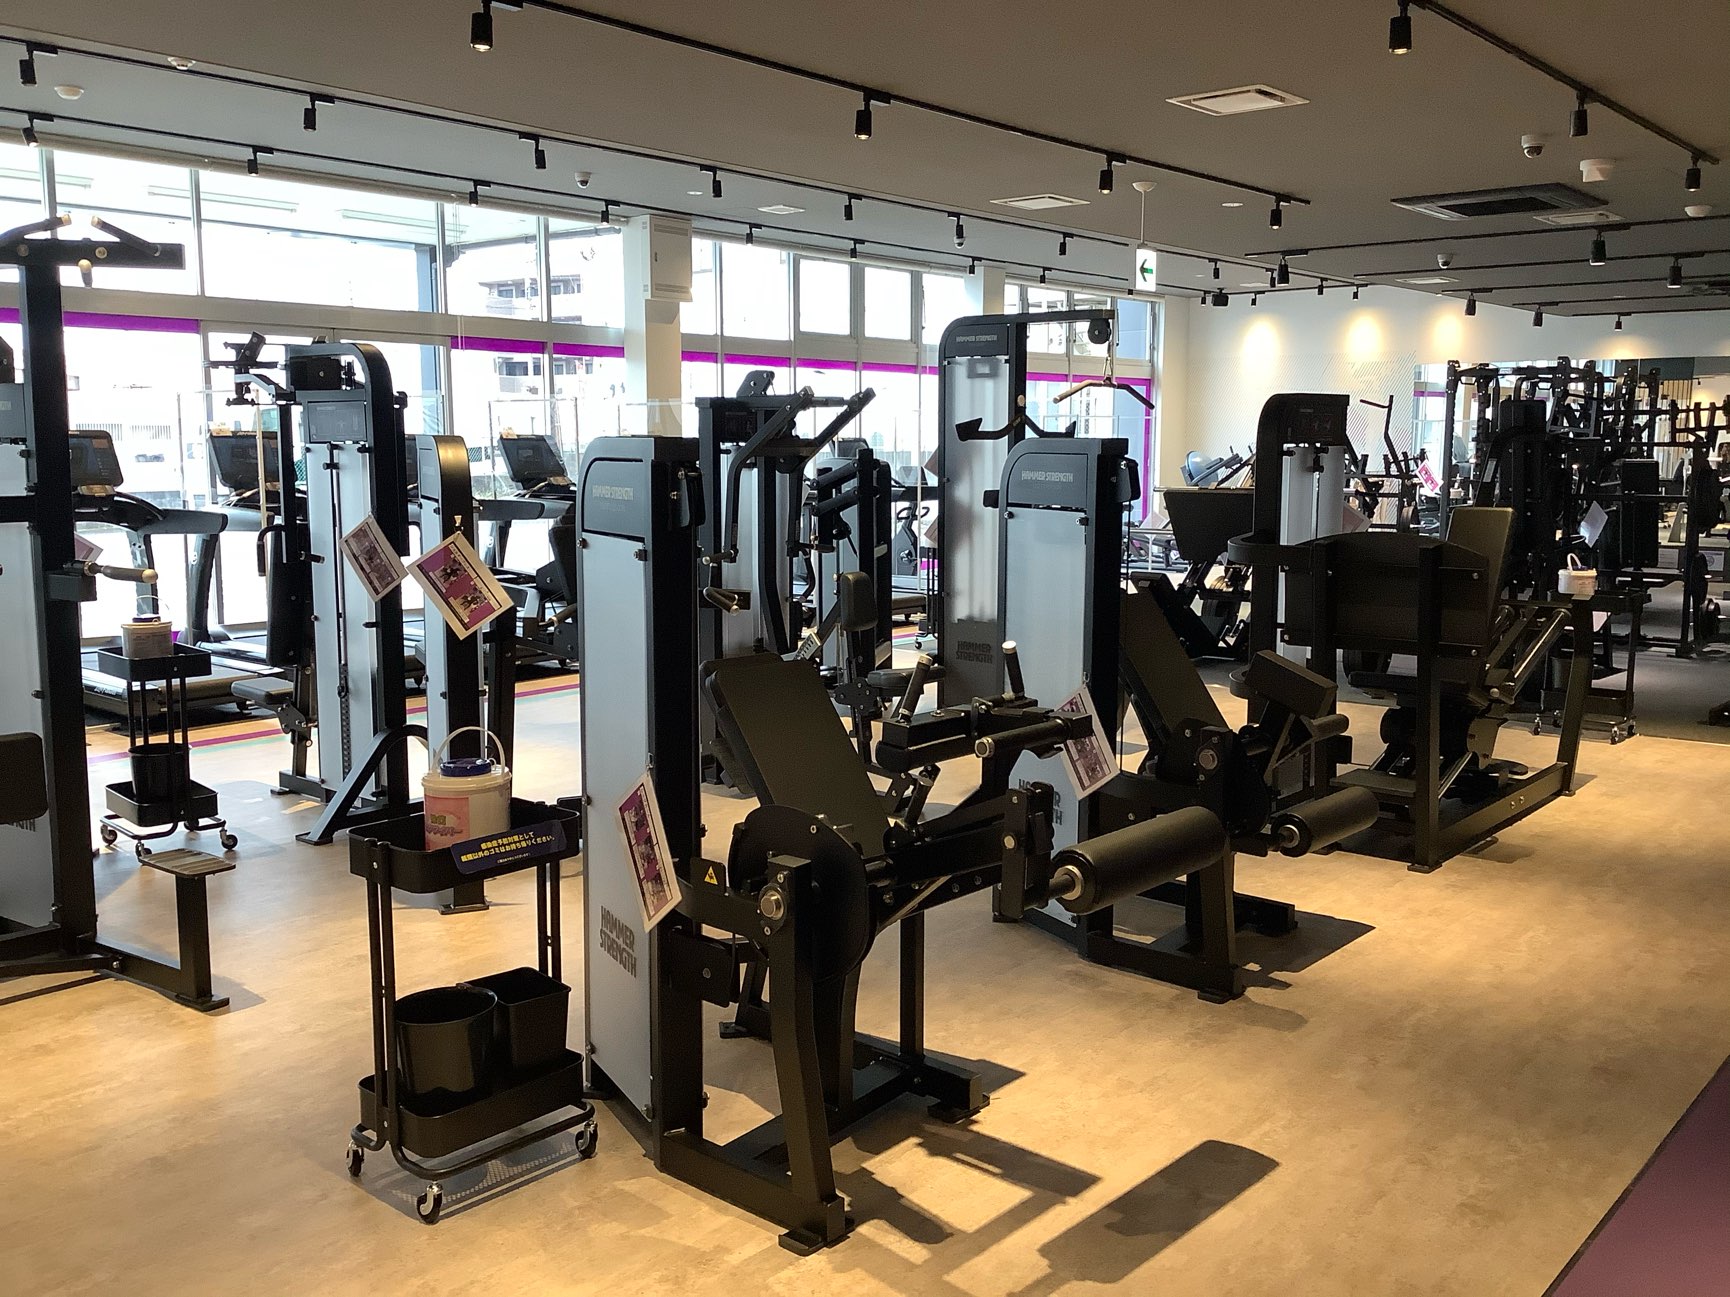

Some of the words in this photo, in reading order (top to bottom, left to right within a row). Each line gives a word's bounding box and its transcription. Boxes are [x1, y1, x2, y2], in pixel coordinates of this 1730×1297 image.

[1021, 470, 1045, 480] HAMMER
[1046, 471, 1073, 482] STRENGTH
[592, 485, 610, 498] HAMMER
[610, 486, 633, 500] STRENGTH
[957, 640, 991, 653] HAMMER
[956, 651, 993, 664] STRENGTH
[601, 905, 634, 952] HAMMER
[600, 928, 636, 978] STRENGTH
